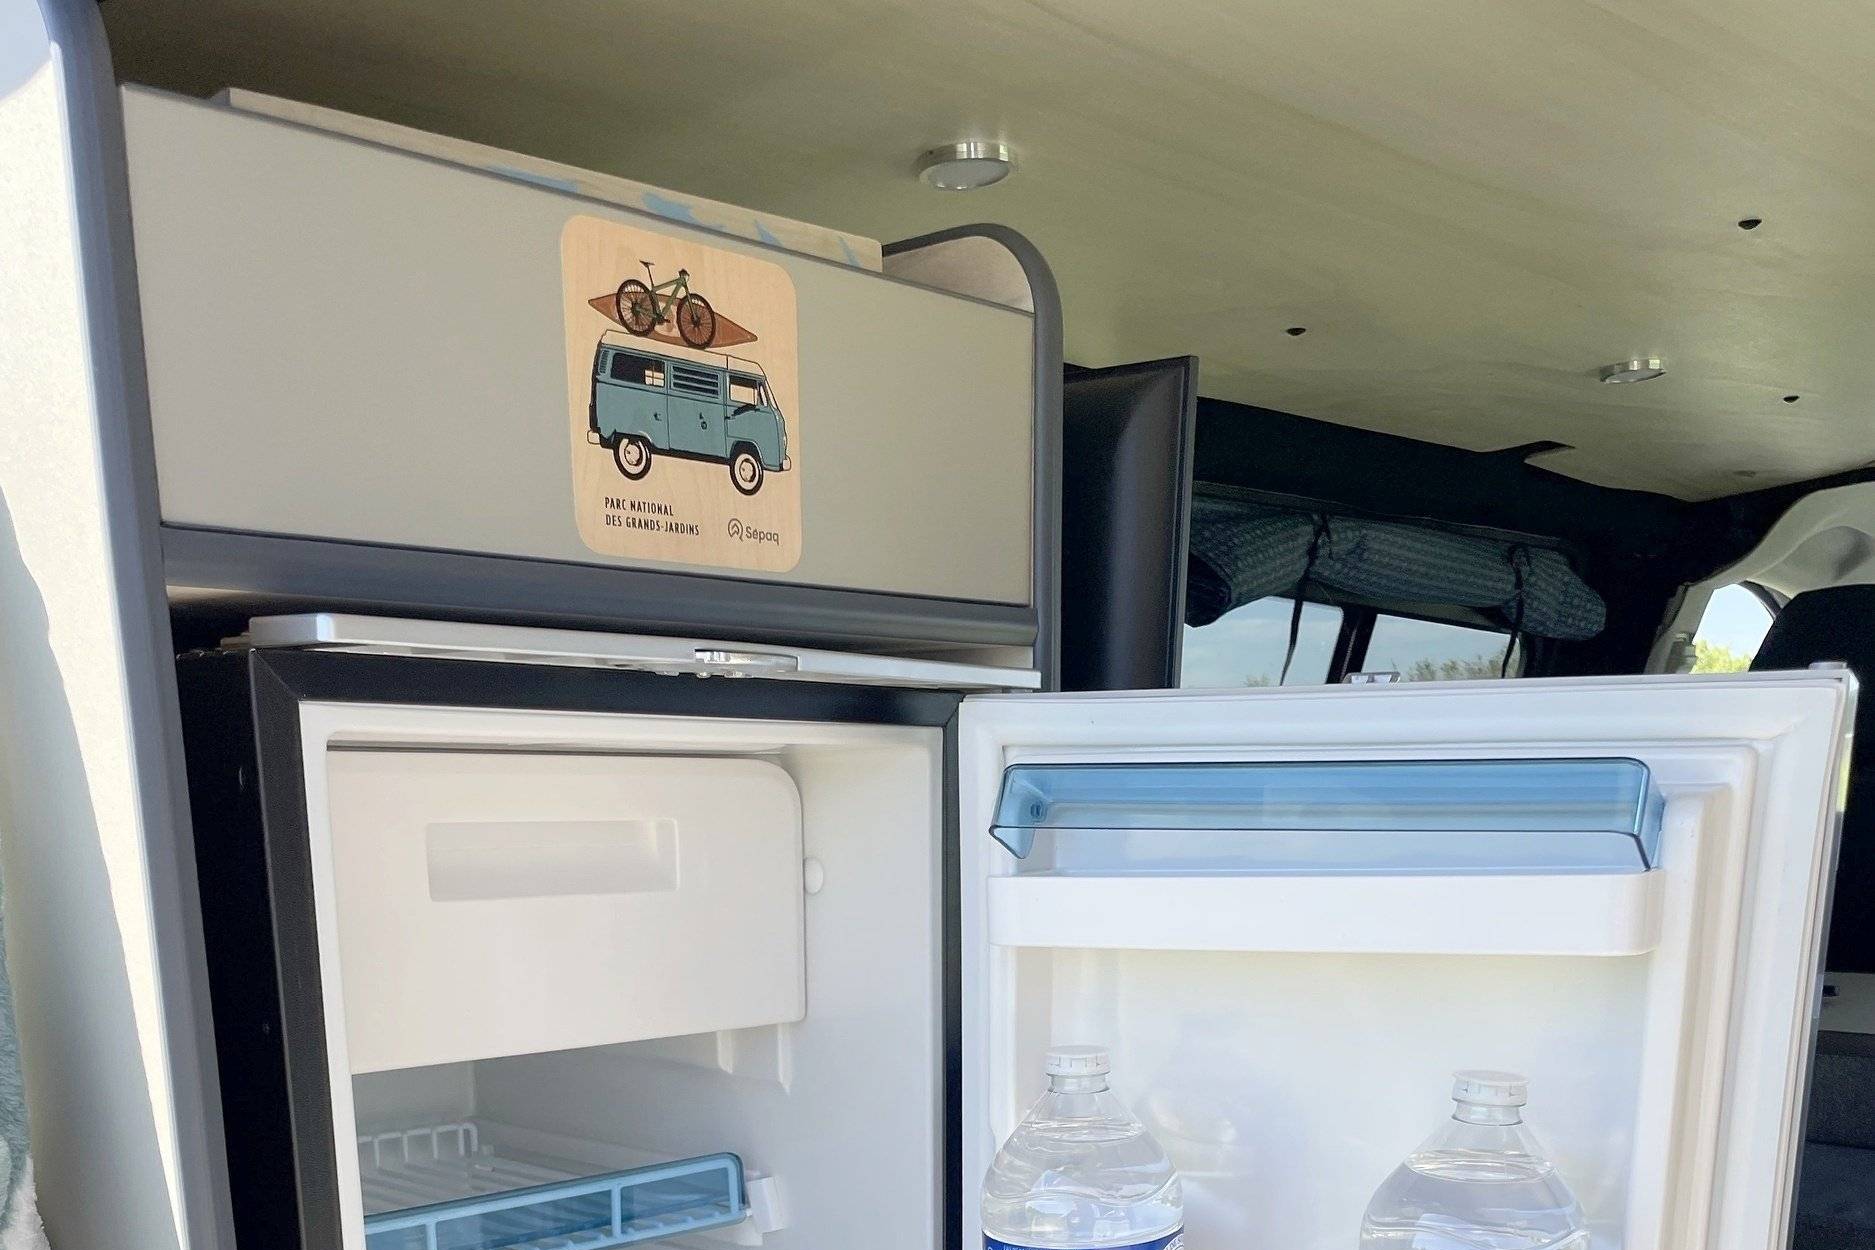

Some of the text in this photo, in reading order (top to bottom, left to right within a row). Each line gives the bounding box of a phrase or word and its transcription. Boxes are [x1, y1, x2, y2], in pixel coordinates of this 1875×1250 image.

[605, 497, 674, 517] PARC NATIONAL
[605, 514, 700, 536] DES GRANDS-JARDINS
[745, 526, 780, 546] Sépaq
